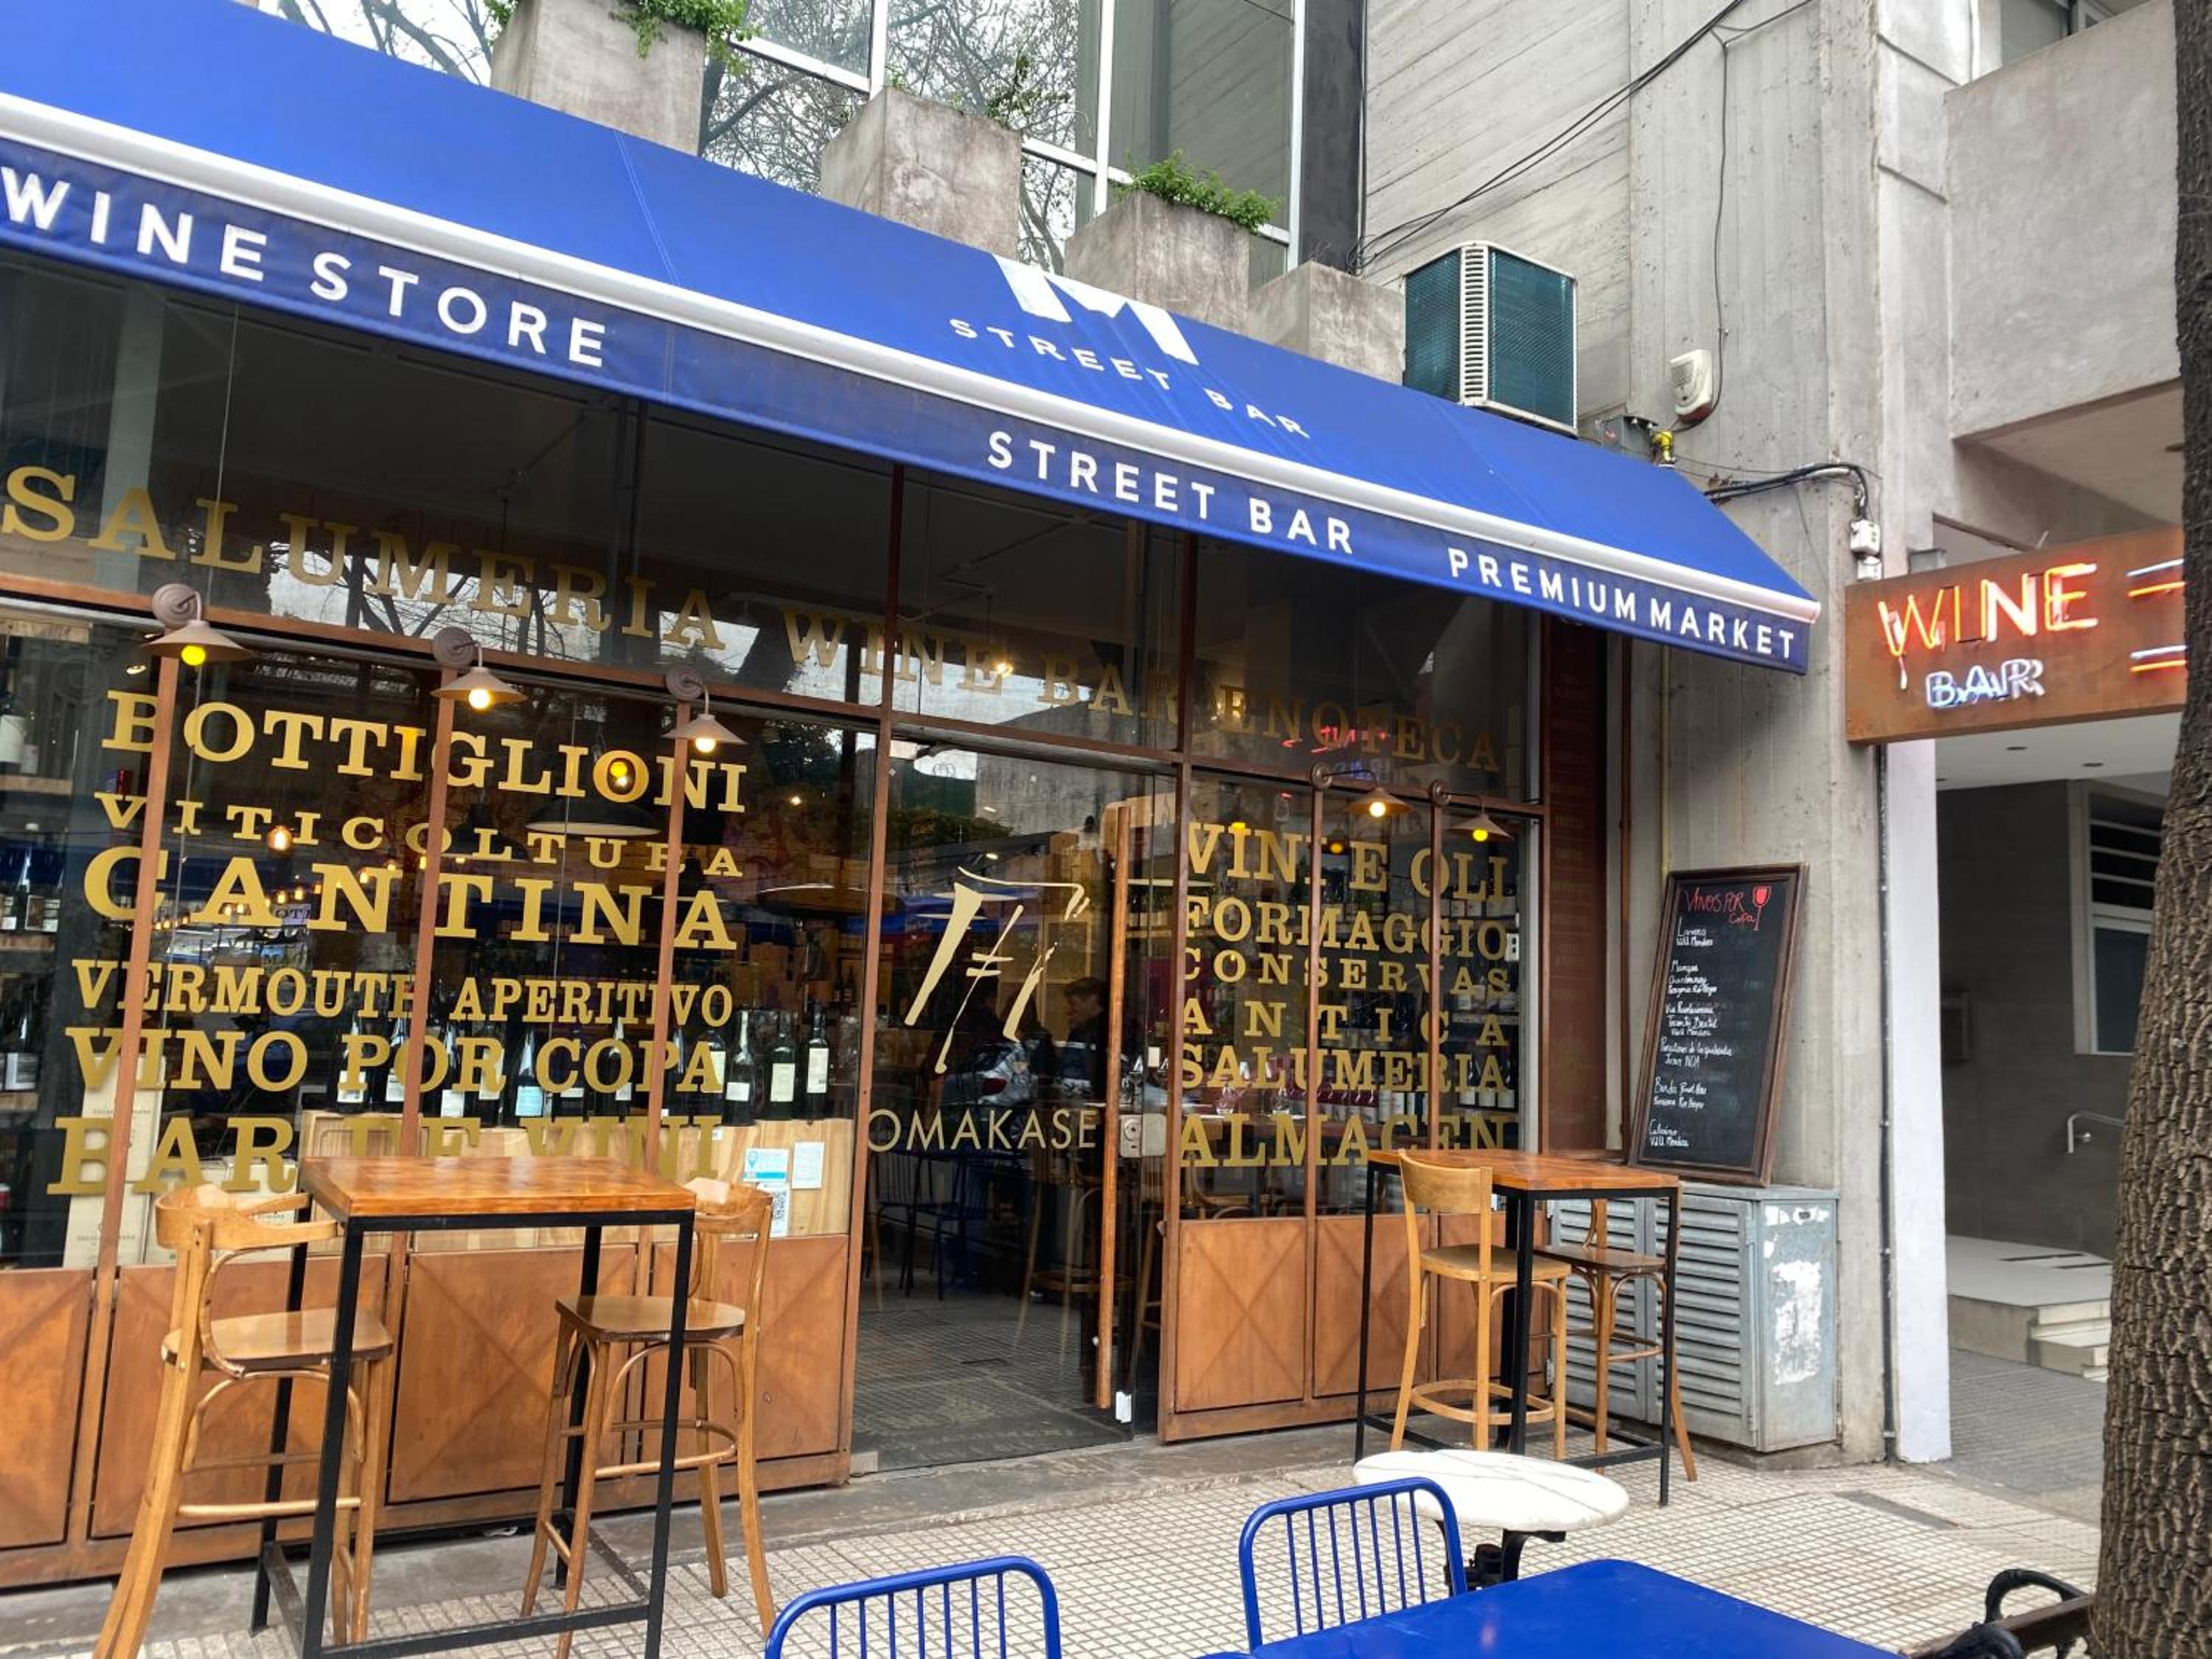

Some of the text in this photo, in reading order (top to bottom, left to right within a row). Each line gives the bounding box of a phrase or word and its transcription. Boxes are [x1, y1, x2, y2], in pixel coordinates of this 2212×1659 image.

[1, 166, 606, 368] WINE STORE
[950, 318, 1310, 439] STREET BAR
[987, 431, 1354, 554] STREET BAR
[1, 465, 1500, 772] SALUMERIA WINE BAR ENOTECA
[1447, 547, 1795, 660] PREMIUM MARKET
[1878, 563, 2099, 657] WINE
[1925, 658, 2045, 709] BAR
[101, 689, 747, 813] BOTTIGLIONI
[93, 792, 742, 877] VITICOLTURA
[1349, 840, 1387, 892] E
[1410, 848, 1509, 905] OLI
[83, 846, 737, 950] CANTINA
[1184, 894, 1509, 961] FORMAGGIO
[448, 976, 733, 1028] APERITIVO
[1184, 946, 1510, 998] CONSERVAS
[64, 1026, 308, 1092] VINO
[339, 1034, 507, 1094] POR
[535, 1037, 724, 1094] COPA
[1183, 997, 1510, 1047] ANTICA
[1182, 1041, 1508, 1094] SALUMERIA
[46, 1116, 297, 1194] BAR
[867, 1107, 1099, 1153] OMAKASE
